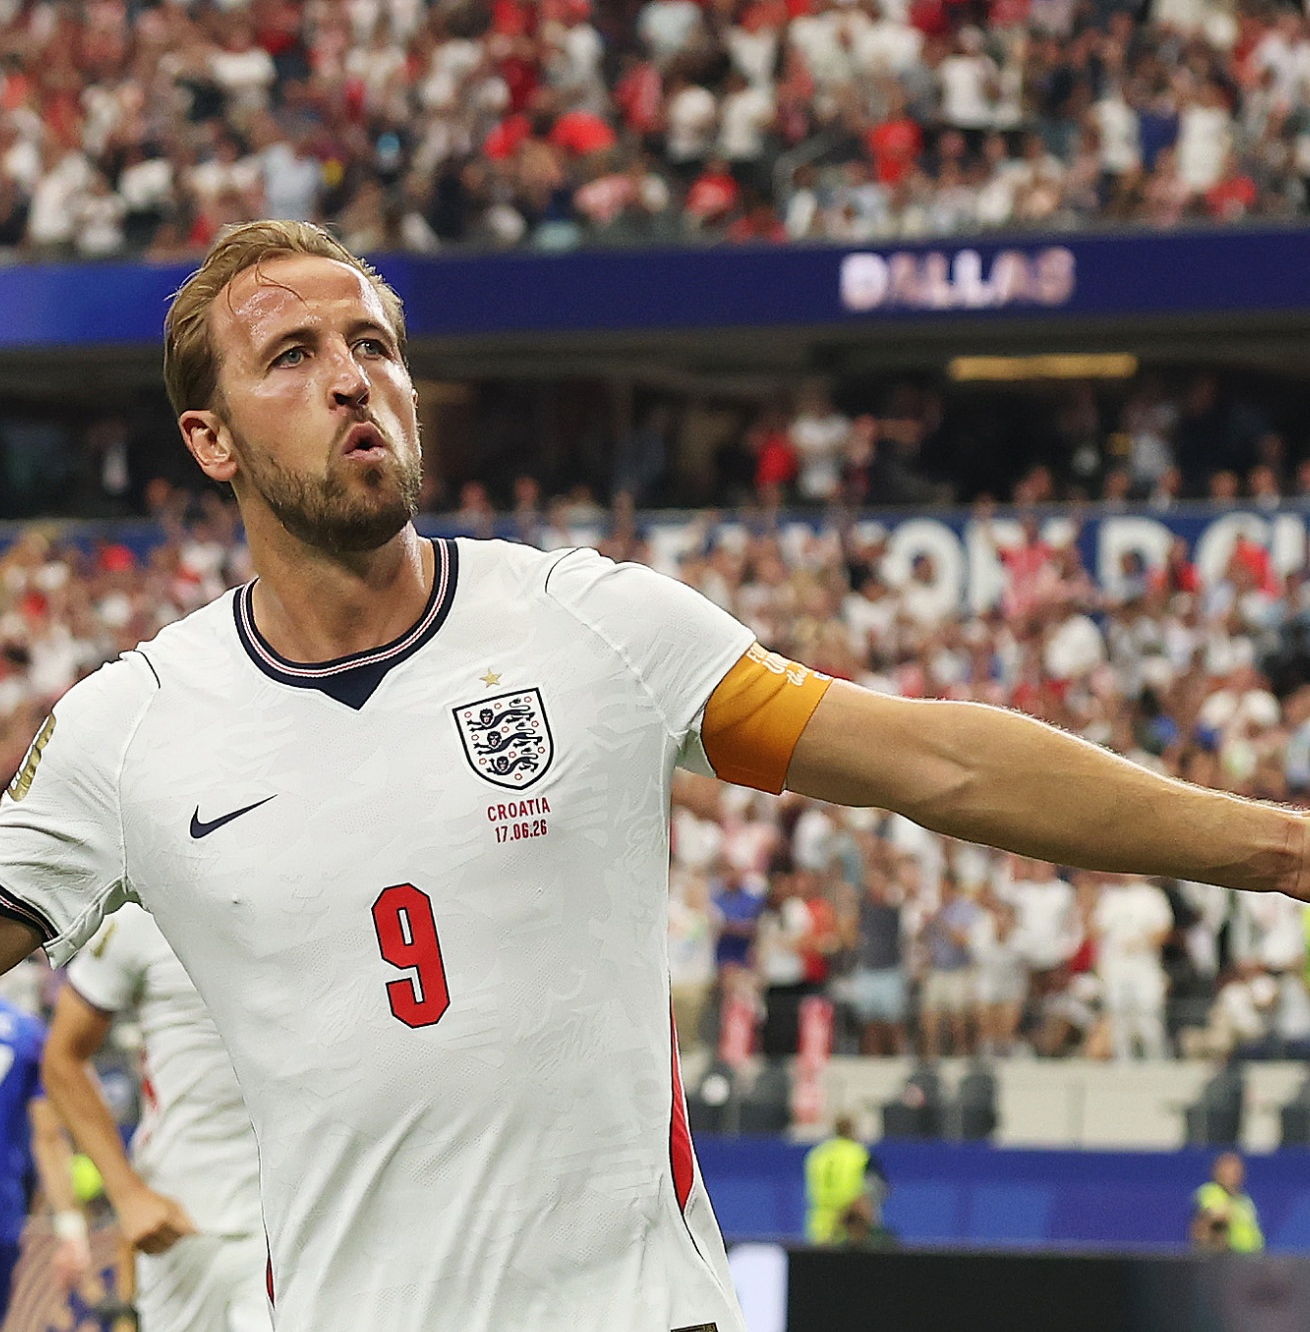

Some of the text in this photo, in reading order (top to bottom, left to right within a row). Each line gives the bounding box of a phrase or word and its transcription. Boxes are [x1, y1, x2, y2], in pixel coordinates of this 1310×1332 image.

[487, 796, 551, 822] CROATIA
[495, 818, 547, 843] 17.06.26
[371, 883, 450, 1028] 9
